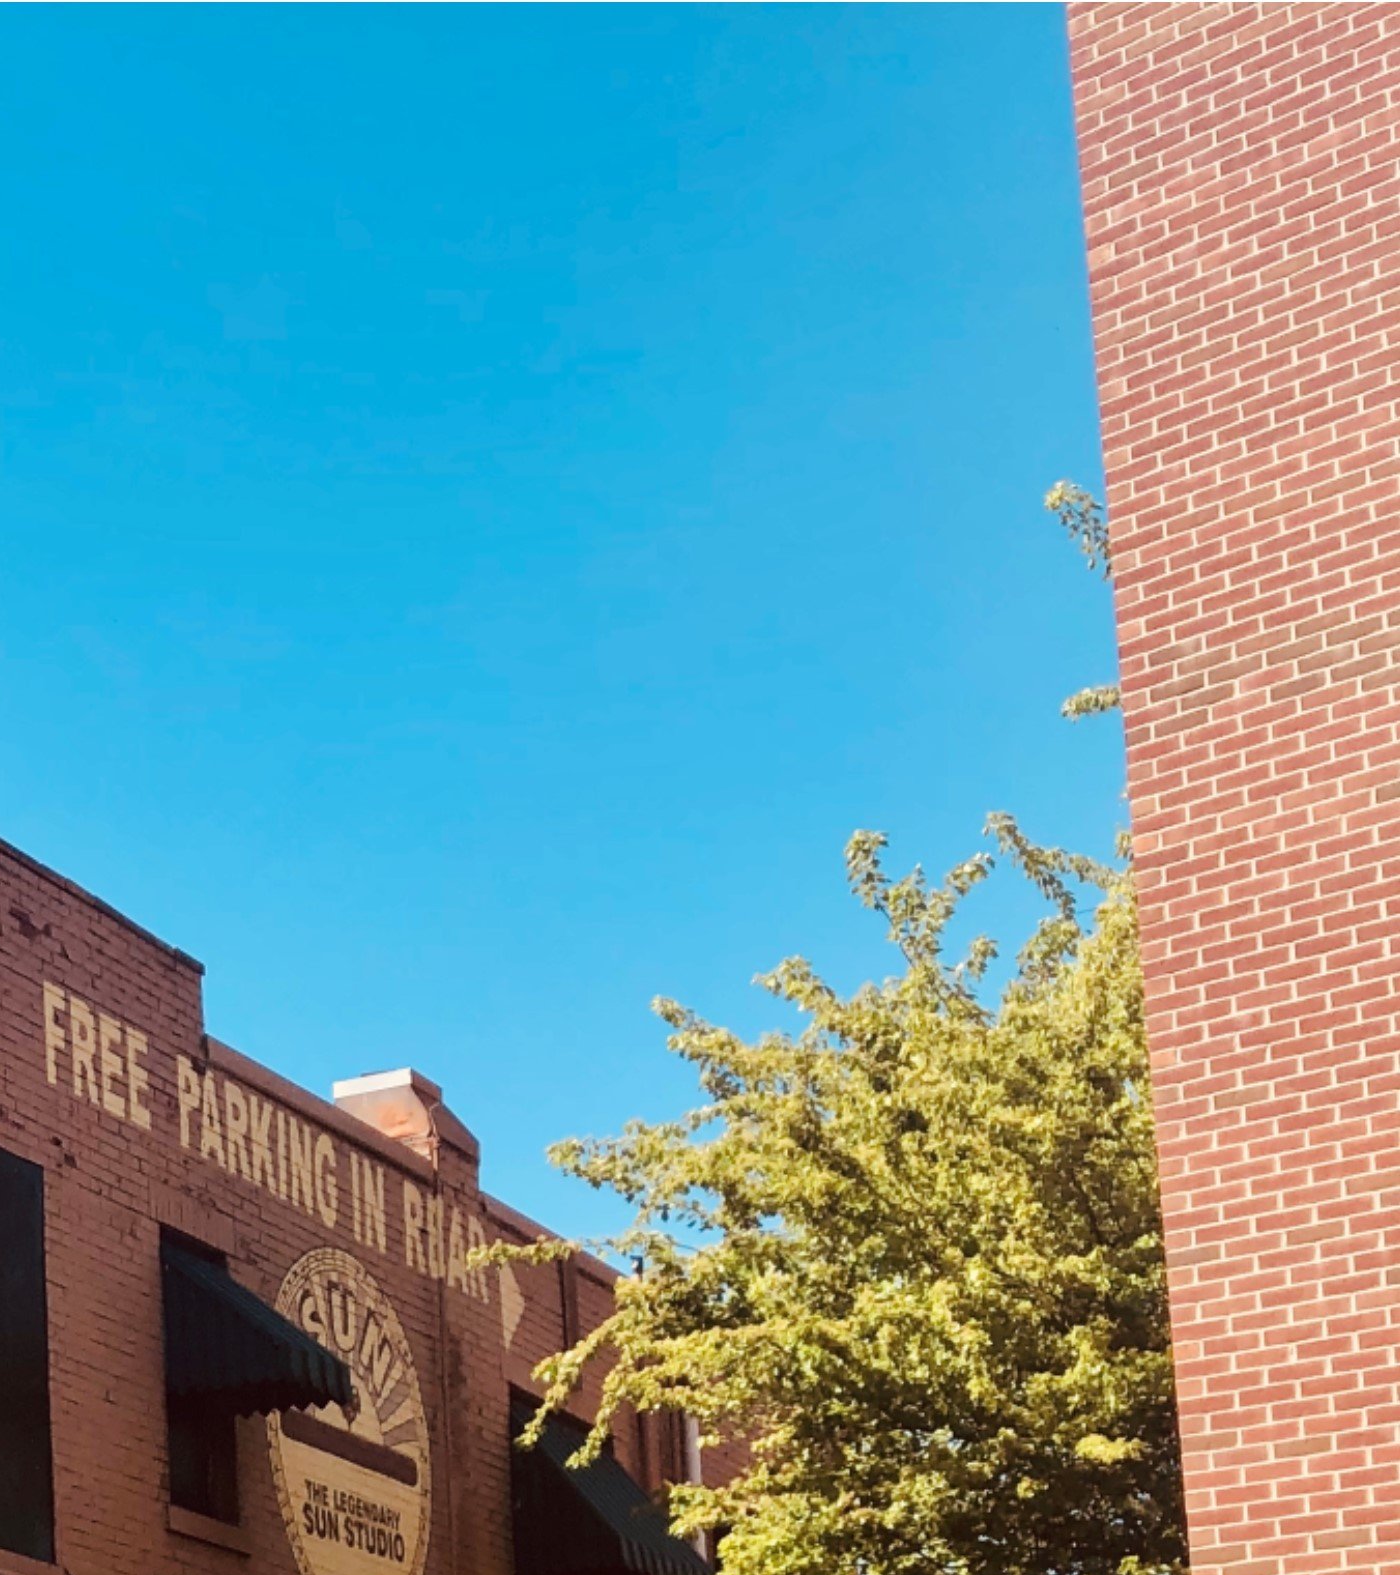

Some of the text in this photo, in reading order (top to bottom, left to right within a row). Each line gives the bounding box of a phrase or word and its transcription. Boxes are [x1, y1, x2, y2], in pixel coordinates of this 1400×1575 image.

[43, 980, 152, 1131] FREE
[176, 1053, 338, 1229] PARKING
[351, 1150, 387, 1255] IN
[299, 1280, 393, 1397] SUN
[302, 1502, 405, 1563] SUN STUDIO
[304, 1478, 401, 1532] THE LEGENDARY
